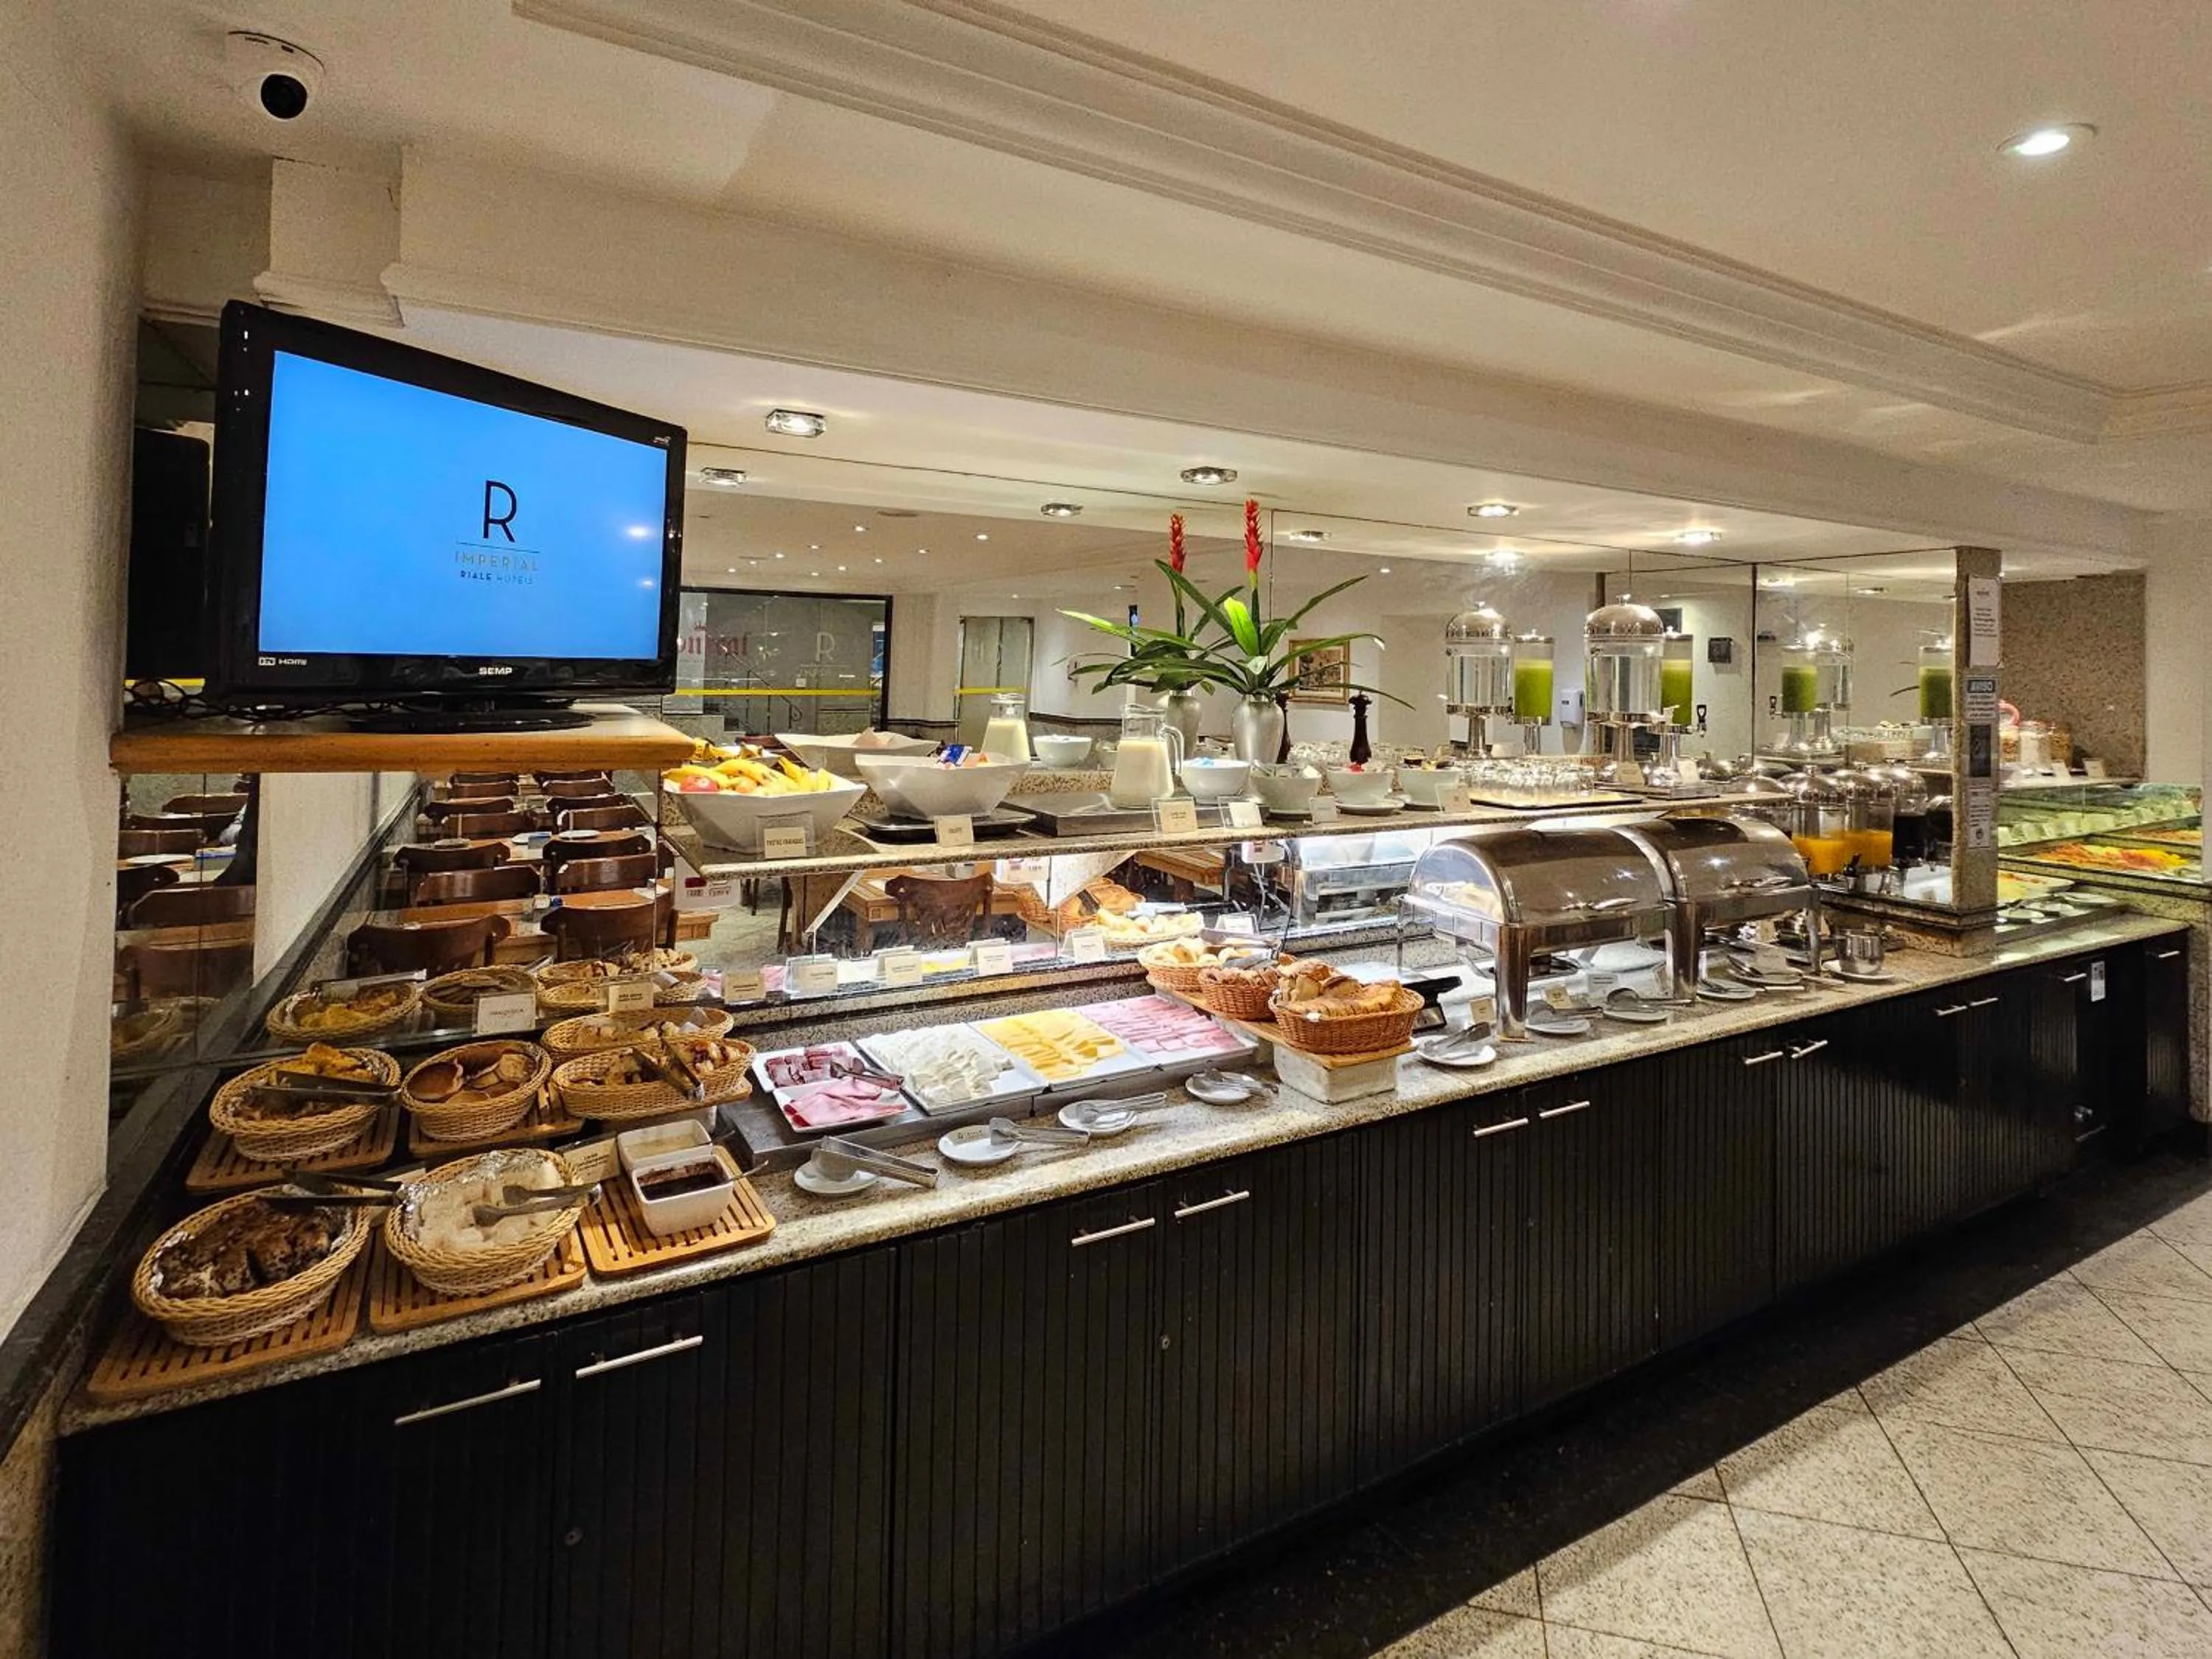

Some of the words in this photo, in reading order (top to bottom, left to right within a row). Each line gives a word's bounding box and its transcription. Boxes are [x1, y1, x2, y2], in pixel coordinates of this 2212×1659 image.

[484, 480, 517, 543] R
[454, 551, 539, 571] IMPERIAL
[479, 667, 512, 675] SEMP
